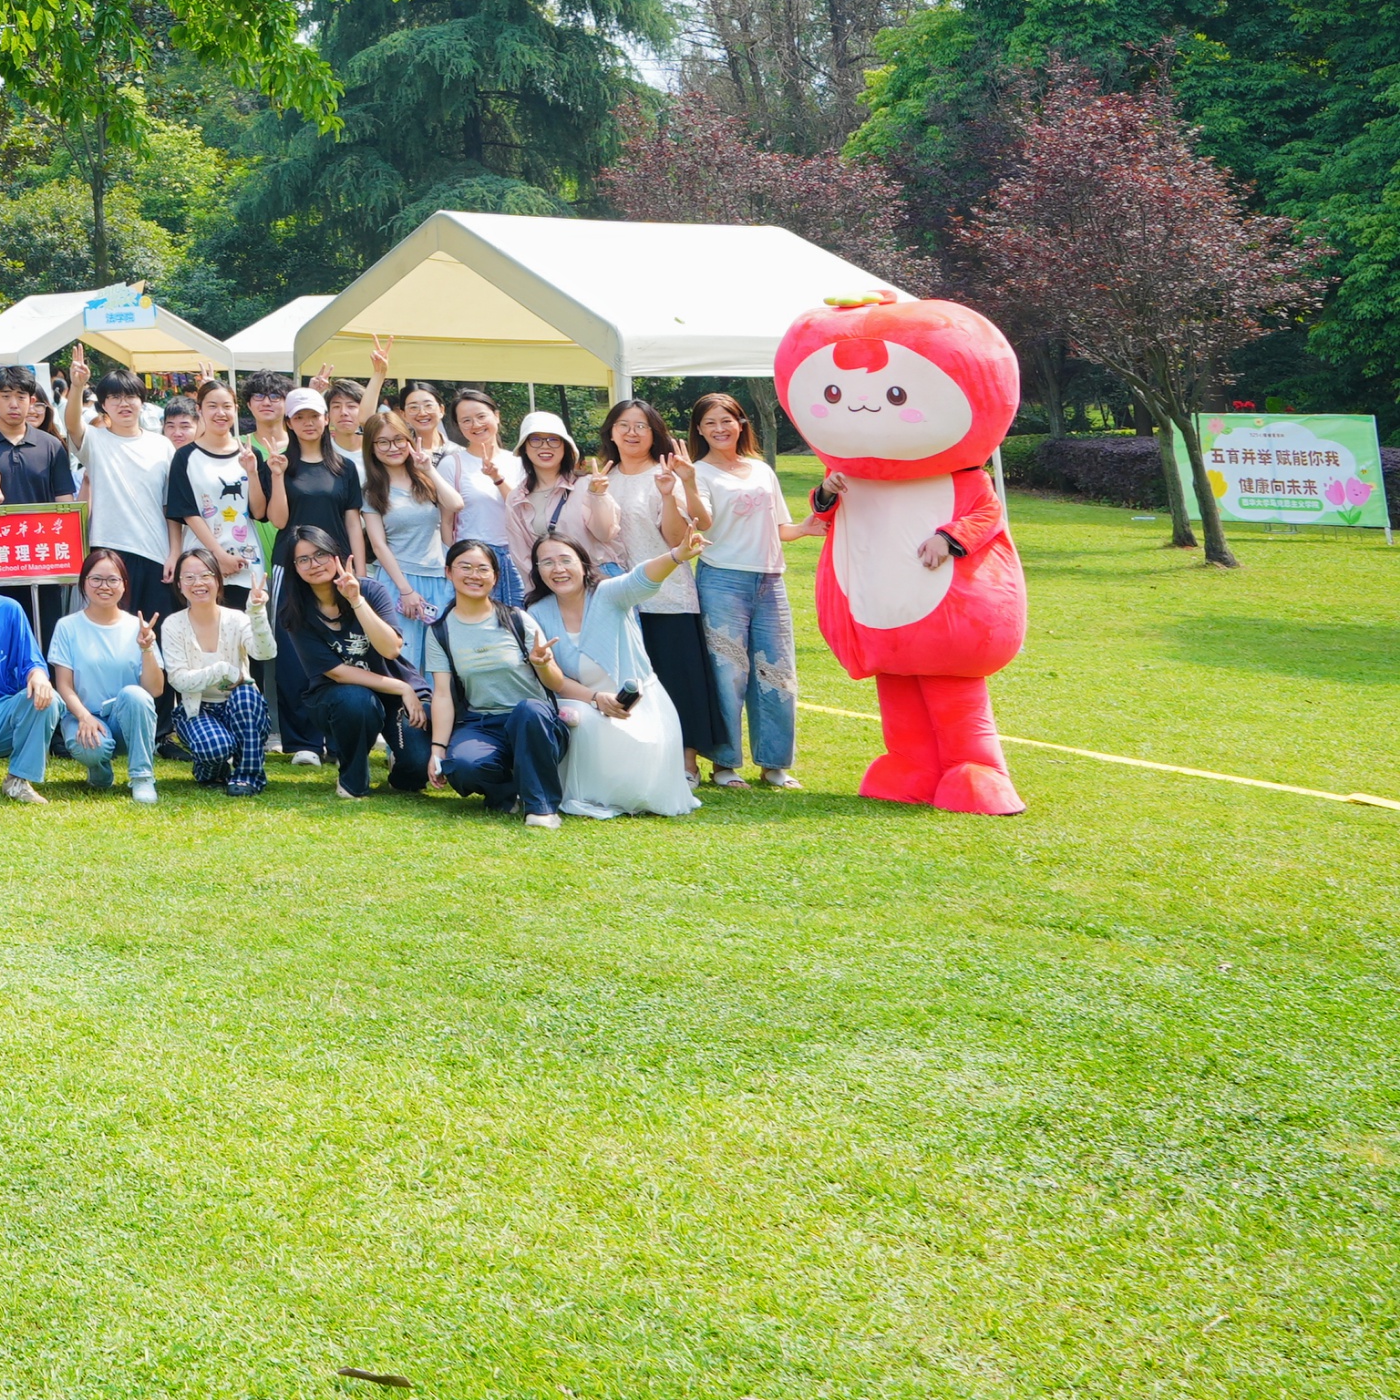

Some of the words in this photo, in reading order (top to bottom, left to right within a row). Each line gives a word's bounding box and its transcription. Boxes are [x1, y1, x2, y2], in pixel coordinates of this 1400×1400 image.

[1210, 447, 1272, 466] 五育并举
[1275, 448, 1341, 467] 赋能你我
[1238, 476, 1319, 496] 健康向未来
[0, 518, 63, 538] 西华大学
[20, 563, 28, 571] of
[28, 562, 71, 571] Management
